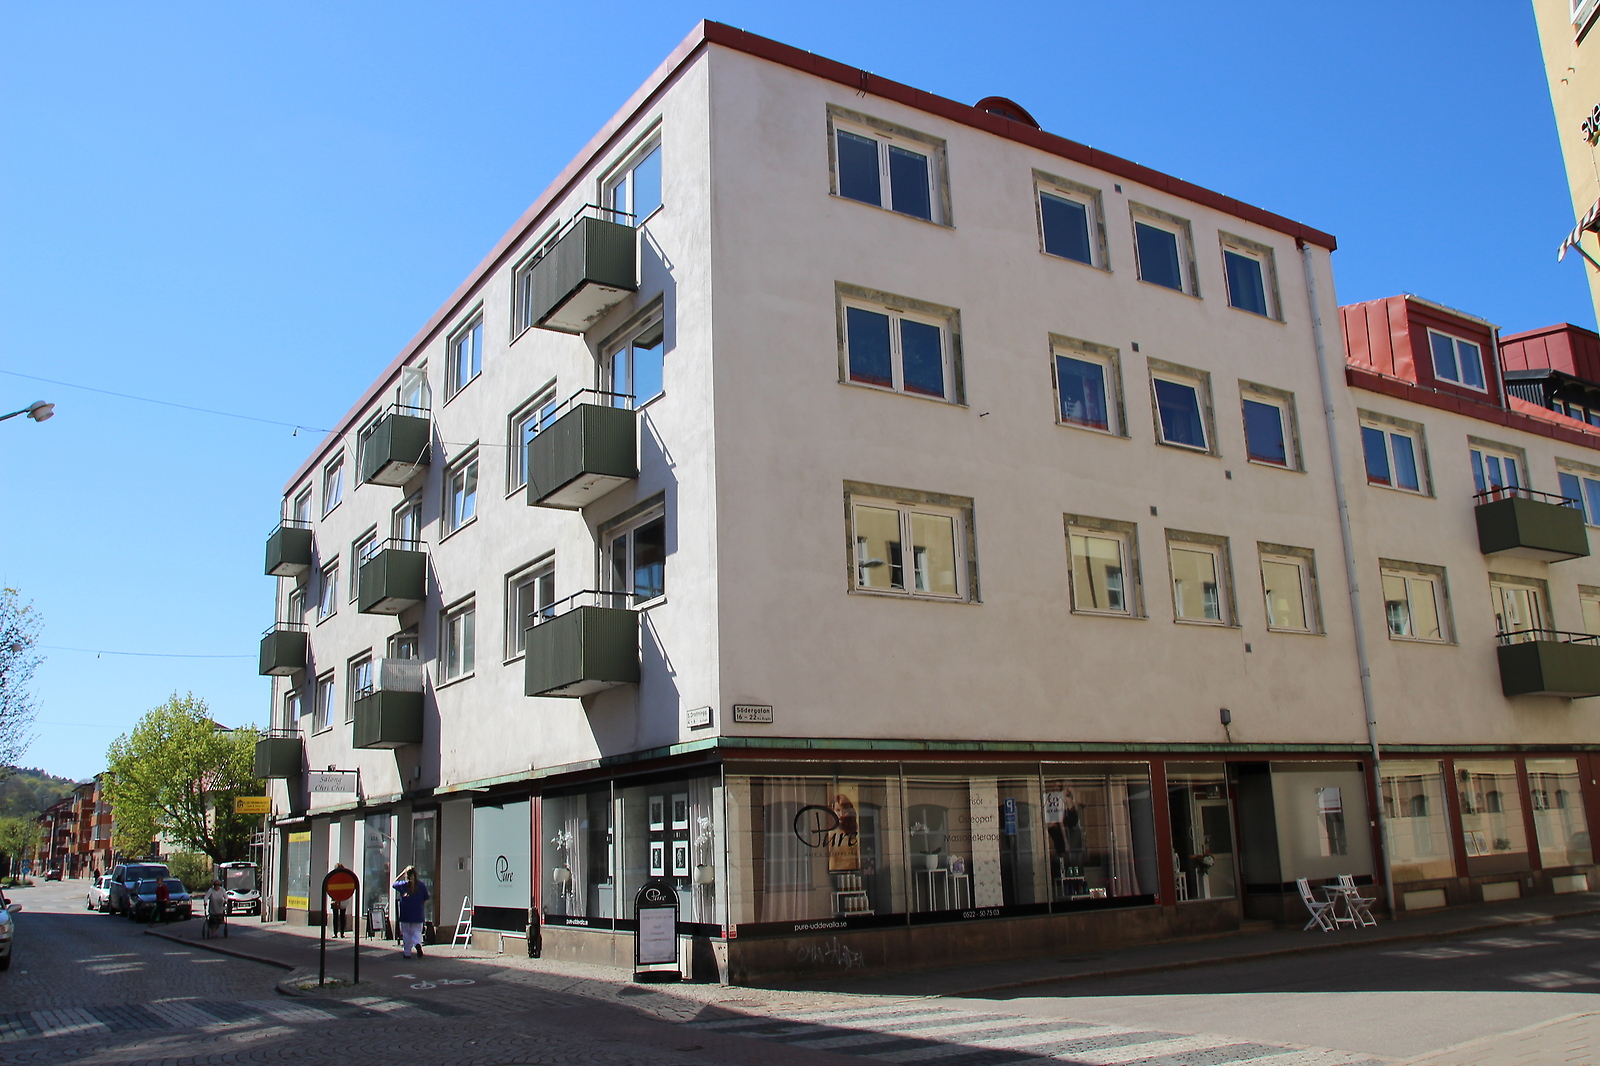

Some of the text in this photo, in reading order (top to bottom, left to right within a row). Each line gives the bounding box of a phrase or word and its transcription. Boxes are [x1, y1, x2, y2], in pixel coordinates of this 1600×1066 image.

[319, 775, 342, 785] Salong
[793, 804, 858, 848] Pure
[958, 814, 993, 825] Oseopat
[495, 854, 514, 883] Pure
[645, 887, 667, 902] Pure
[794, 921, 848, 931] pure-uddevalla.se
